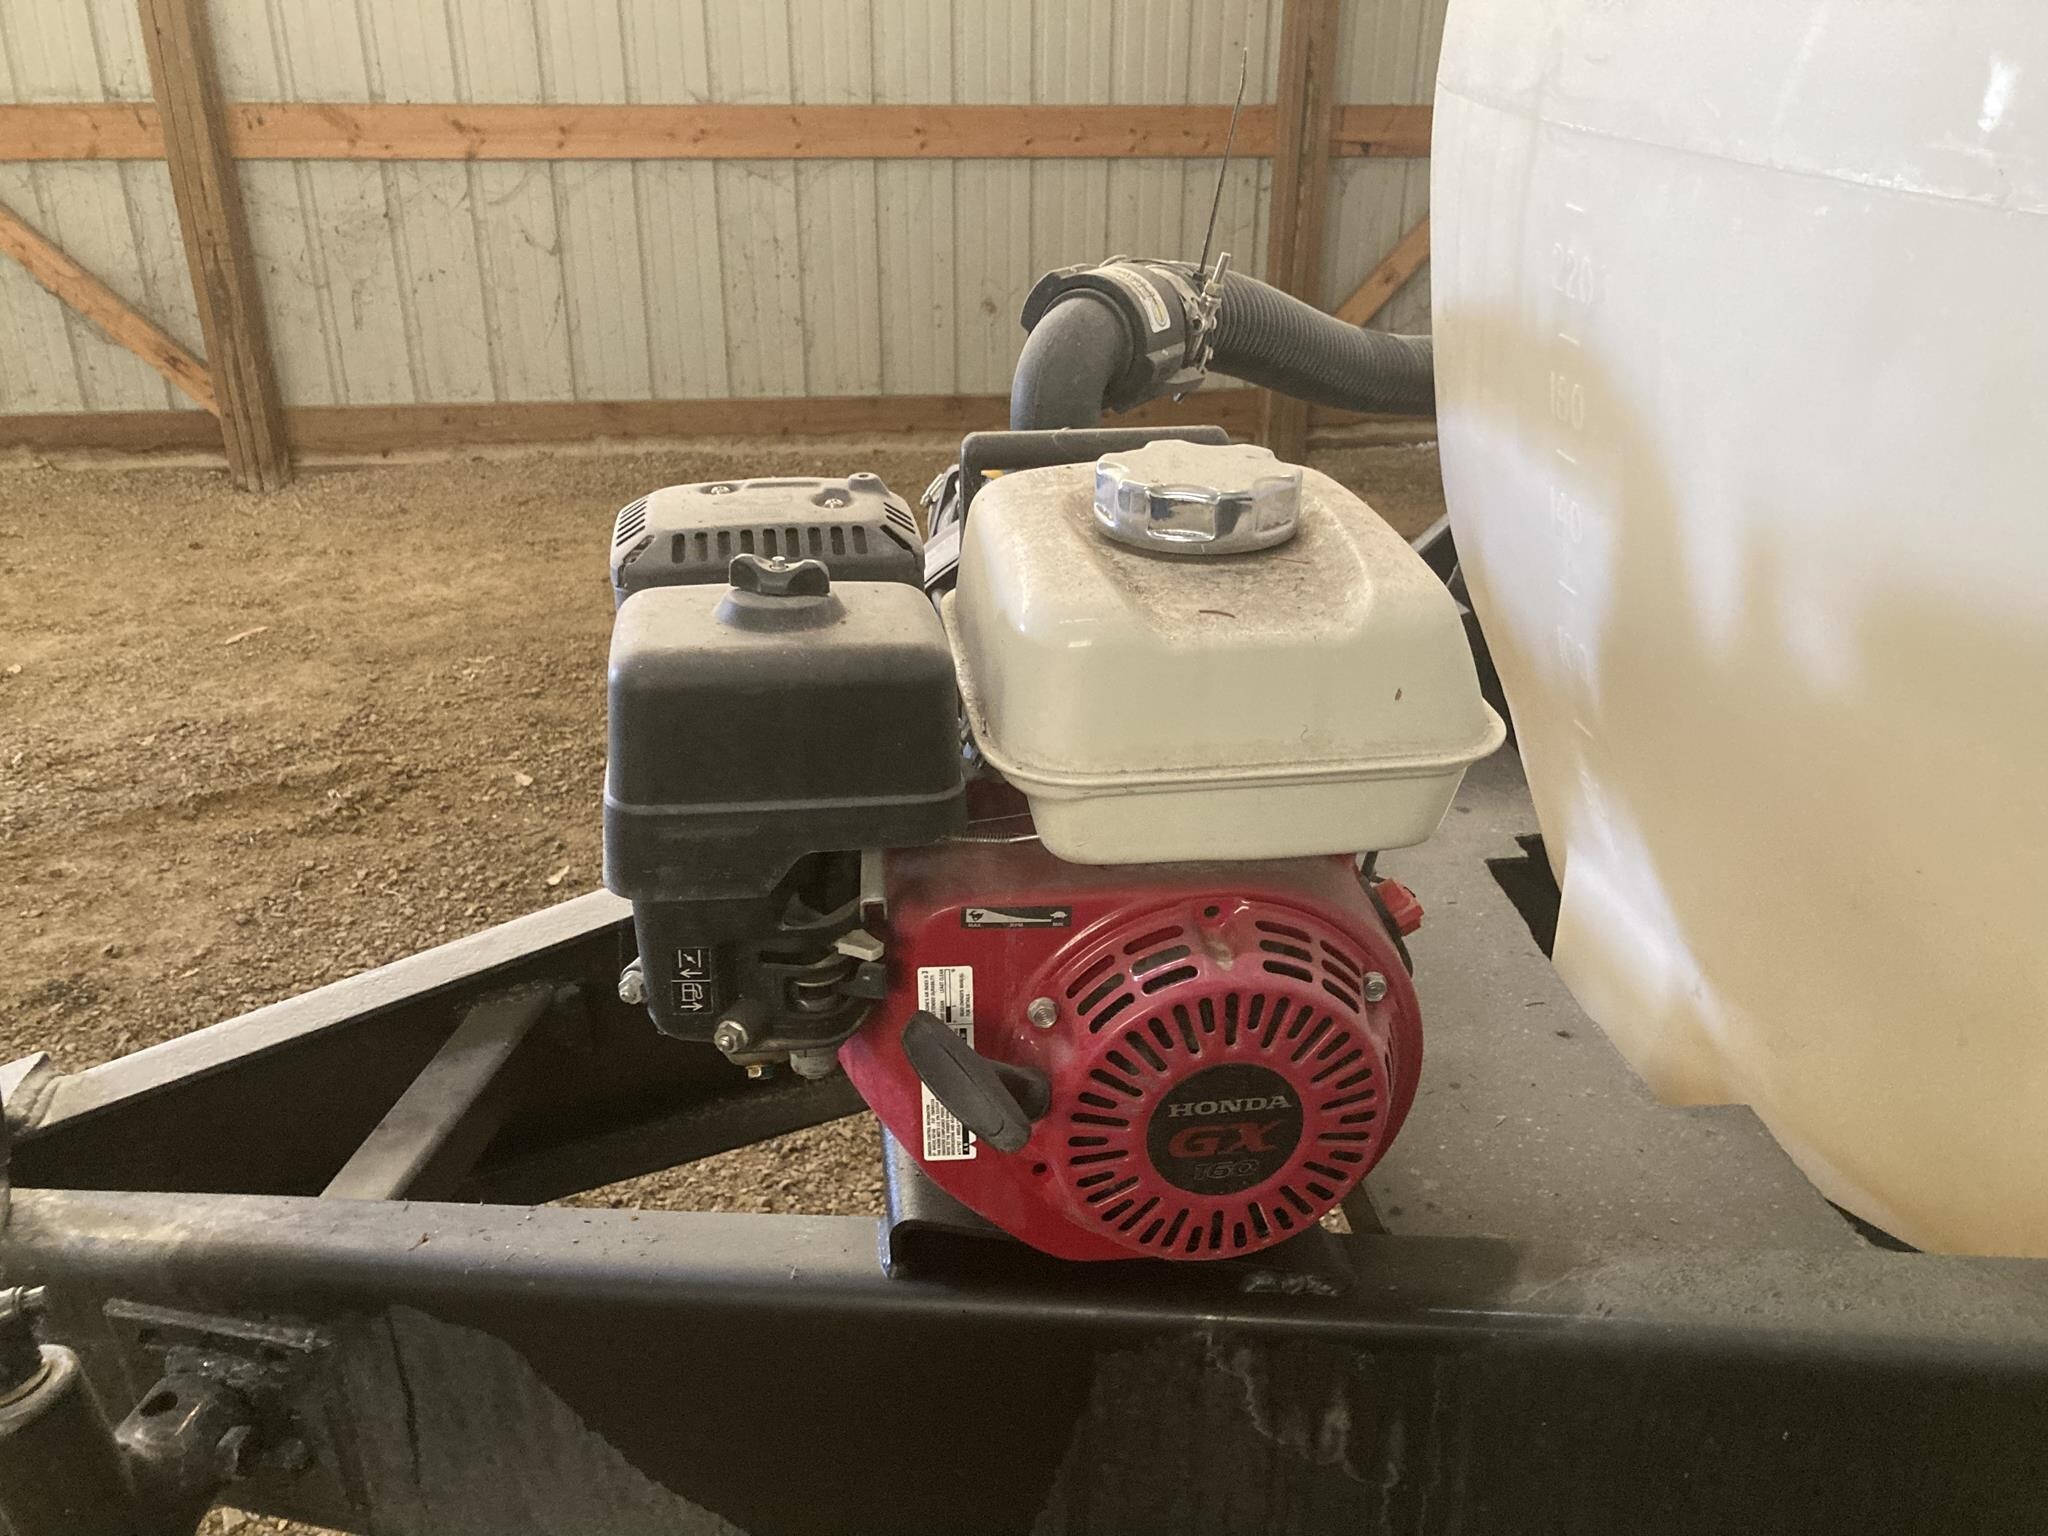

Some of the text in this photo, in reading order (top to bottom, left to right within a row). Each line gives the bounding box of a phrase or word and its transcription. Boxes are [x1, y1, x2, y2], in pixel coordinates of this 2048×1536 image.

[1552, 242, 1593, 305] 220
[1549, 369, 1585, 431] 180
[1167, 1095, 1293, 1118] HONDA
[1167, 1120, 1282, 1159] GX
